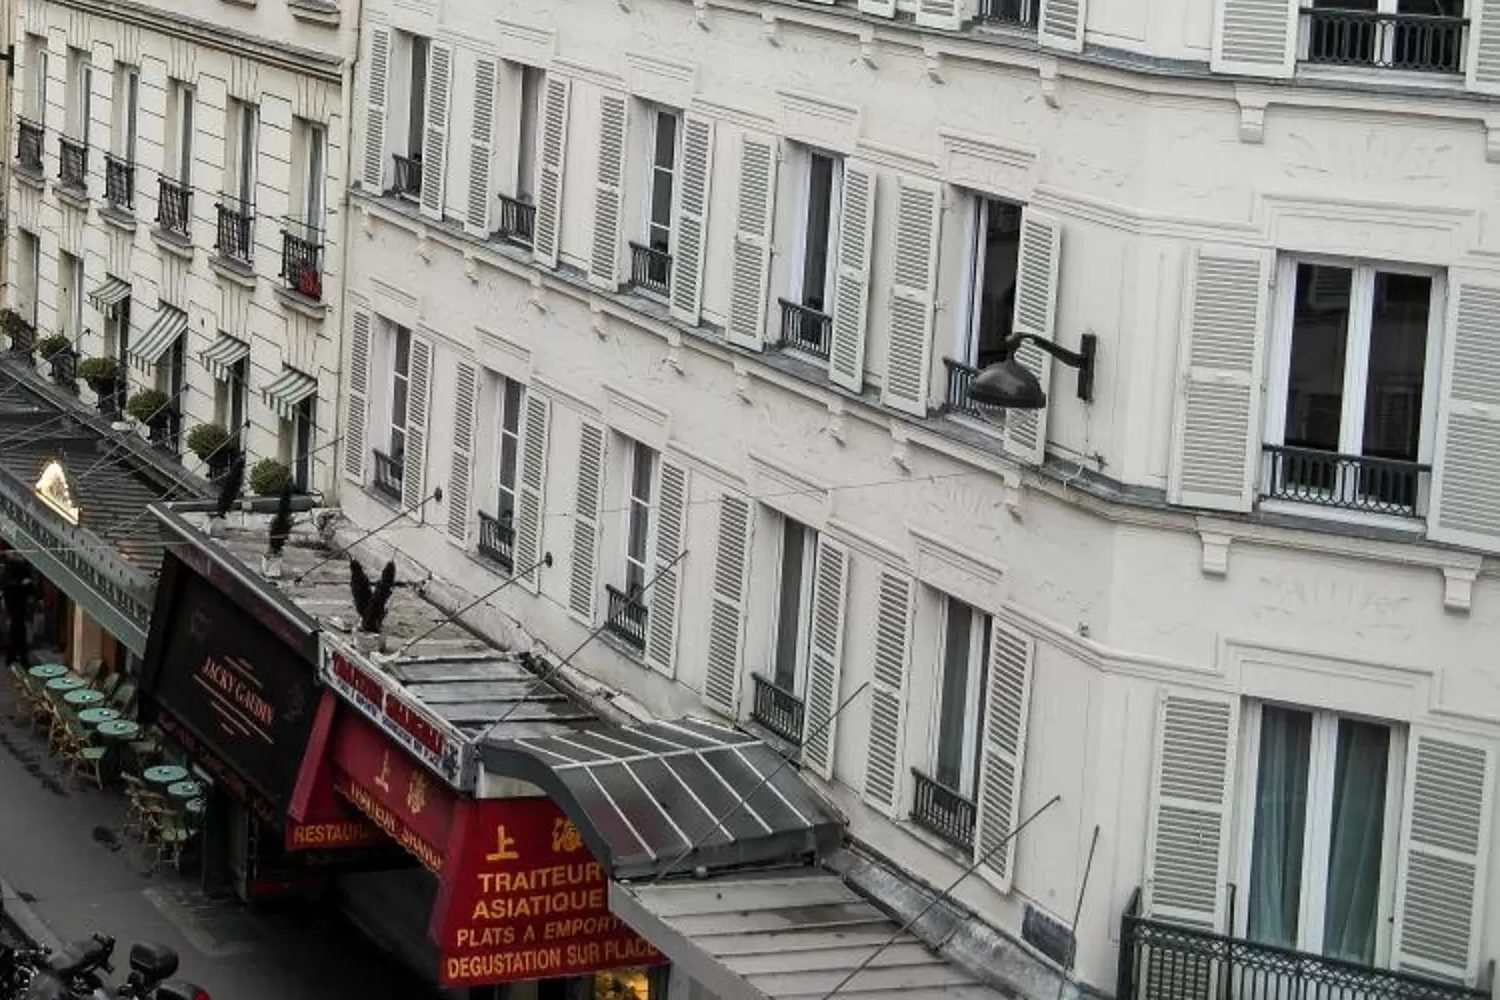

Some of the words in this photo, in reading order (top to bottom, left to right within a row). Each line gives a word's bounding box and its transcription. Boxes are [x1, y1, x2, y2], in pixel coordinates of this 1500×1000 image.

[294, 823, 365, 844] RESTAUR
[477, 861, 602, 894] TRAITEUR
[471, 888, 604, 920] ASIATIQUE
[456, 925, 516, 948] PLATS
[523, 924, 537, 943] A
[544, 915, 625, 941] EMPORT
[447, 947, 562, 979] DEGUSTATION
[566, 942, 601, 966] SUR
